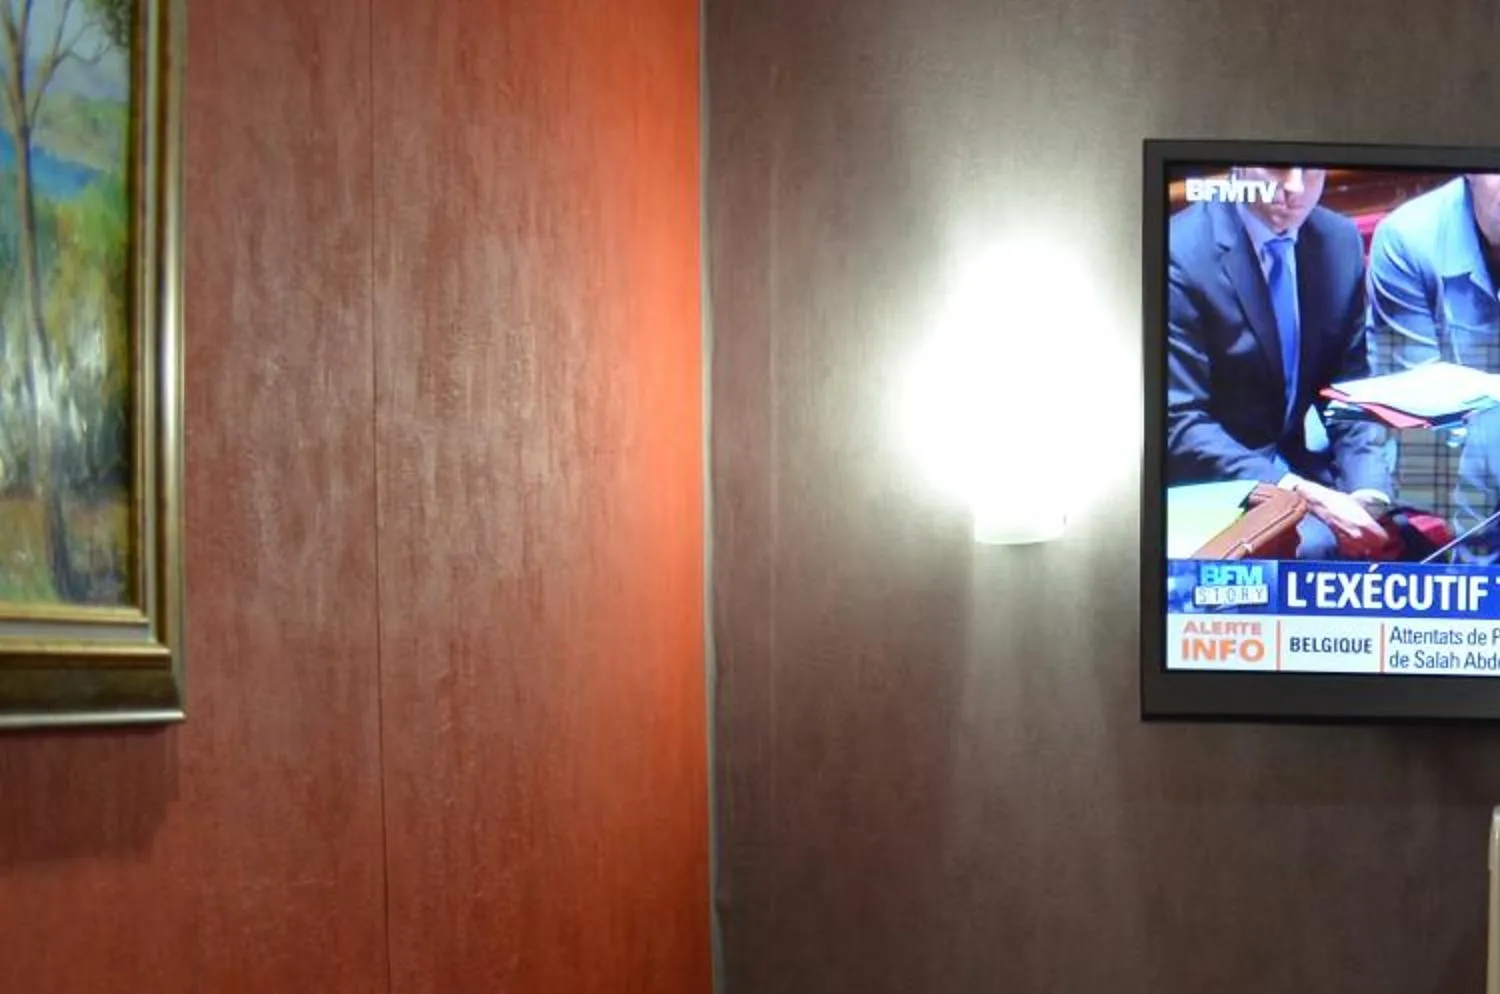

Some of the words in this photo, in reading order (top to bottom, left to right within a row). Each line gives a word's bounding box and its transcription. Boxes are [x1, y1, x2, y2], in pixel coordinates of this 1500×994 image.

[1185, 179, 1277, 203] BFMTV
[1201, 565, 1263, 585] BFM
[1197, 587, 1266, 604] STORY
[1287, 563, 1488, 612] L'EXÉCUTIF
[1183, 621, 1262, 635] ALERTE
[1389, 626, 1464, 646] Attentats
[1467, 628, 1487, 647] de
[1181, 638, 1265, 662] INFO
[1289, 636, 1373, 655] BELGIQUE
[1389, 652, 1410, 669] de
[1413, 650, 1460, 670] Salah
